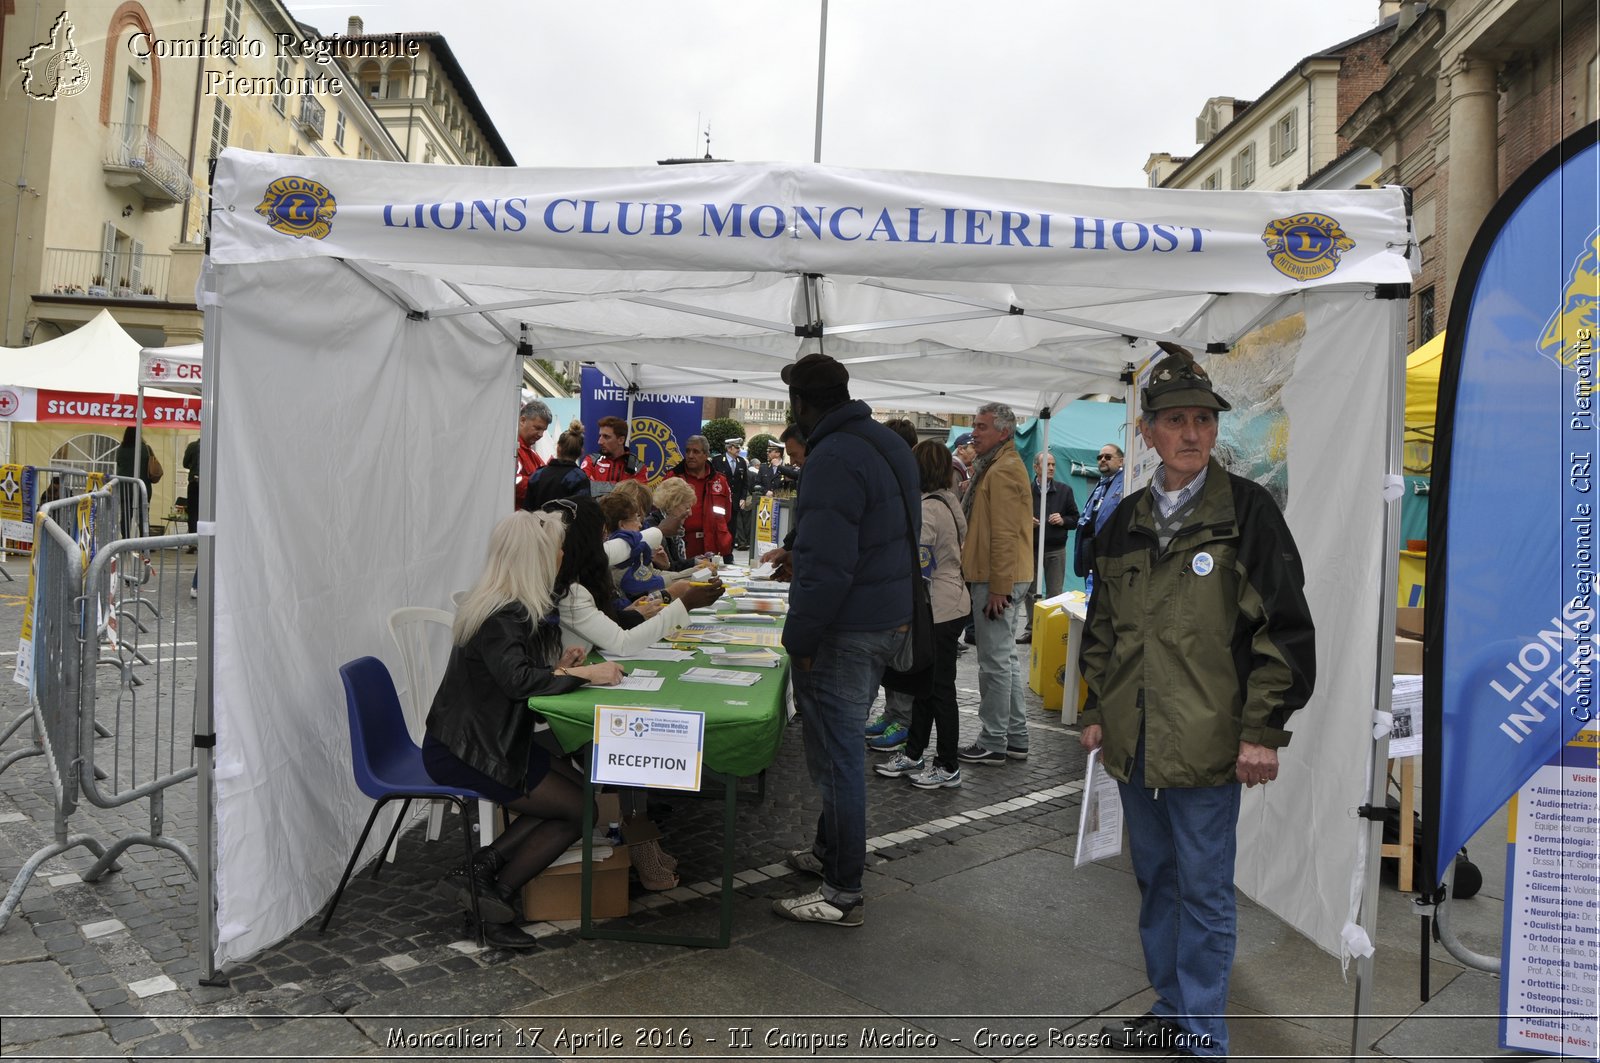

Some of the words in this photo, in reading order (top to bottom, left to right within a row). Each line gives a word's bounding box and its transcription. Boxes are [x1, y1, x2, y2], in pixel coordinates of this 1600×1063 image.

[273, 179, 324, 196] LIONS
[383, 198, 528, 232] LIONS
[543, 198, 683, 236] CLUB
[698, 202, 1057, 248] MONCALIERI
[1069, 216, 1212, 254] HOST
[1279, 216, 1335, 229] LIONS
[1277, 256, 1330, 276] INTERNATIONAL
[153, 406, 202, 421] STRA
[1489, 600, 1596, 702] LIONS
[1499, 633, 1600, 744] INTER
[608, 753, 687, 771] RECEPTION
[1572, 774, 1597, 783] Visite
[1536, 786, 1597, 798] Alimentazione
[1535, 799, 1592, 811] Audiometria:
[1535, 811, 1584, 822] Cardioteam
[1534, 834, 1594, 847] Dermatologia:
[1531, 882, 1571, 893] Glicemia:
[1530, 895, 1583, 907] Misurazione
[1530, 908, 1580, 920] Neurologia:
[1529, 920, 1572, 931] Oculistica
[1529, 933, 1576, 945] Ortodonzia
[1528, 956, 1570, 968] Ortopedia
[1527, 978, 1570, 991] Ortottica:
[1526, 991, 1583, 1006] Osteoporosi:
[1525, 1016, 1569, 1030] Pediatria:
[1525, 1029, 1564, 1043] Emoteca
[1567, 1036, 1590, 1047] Avis:
